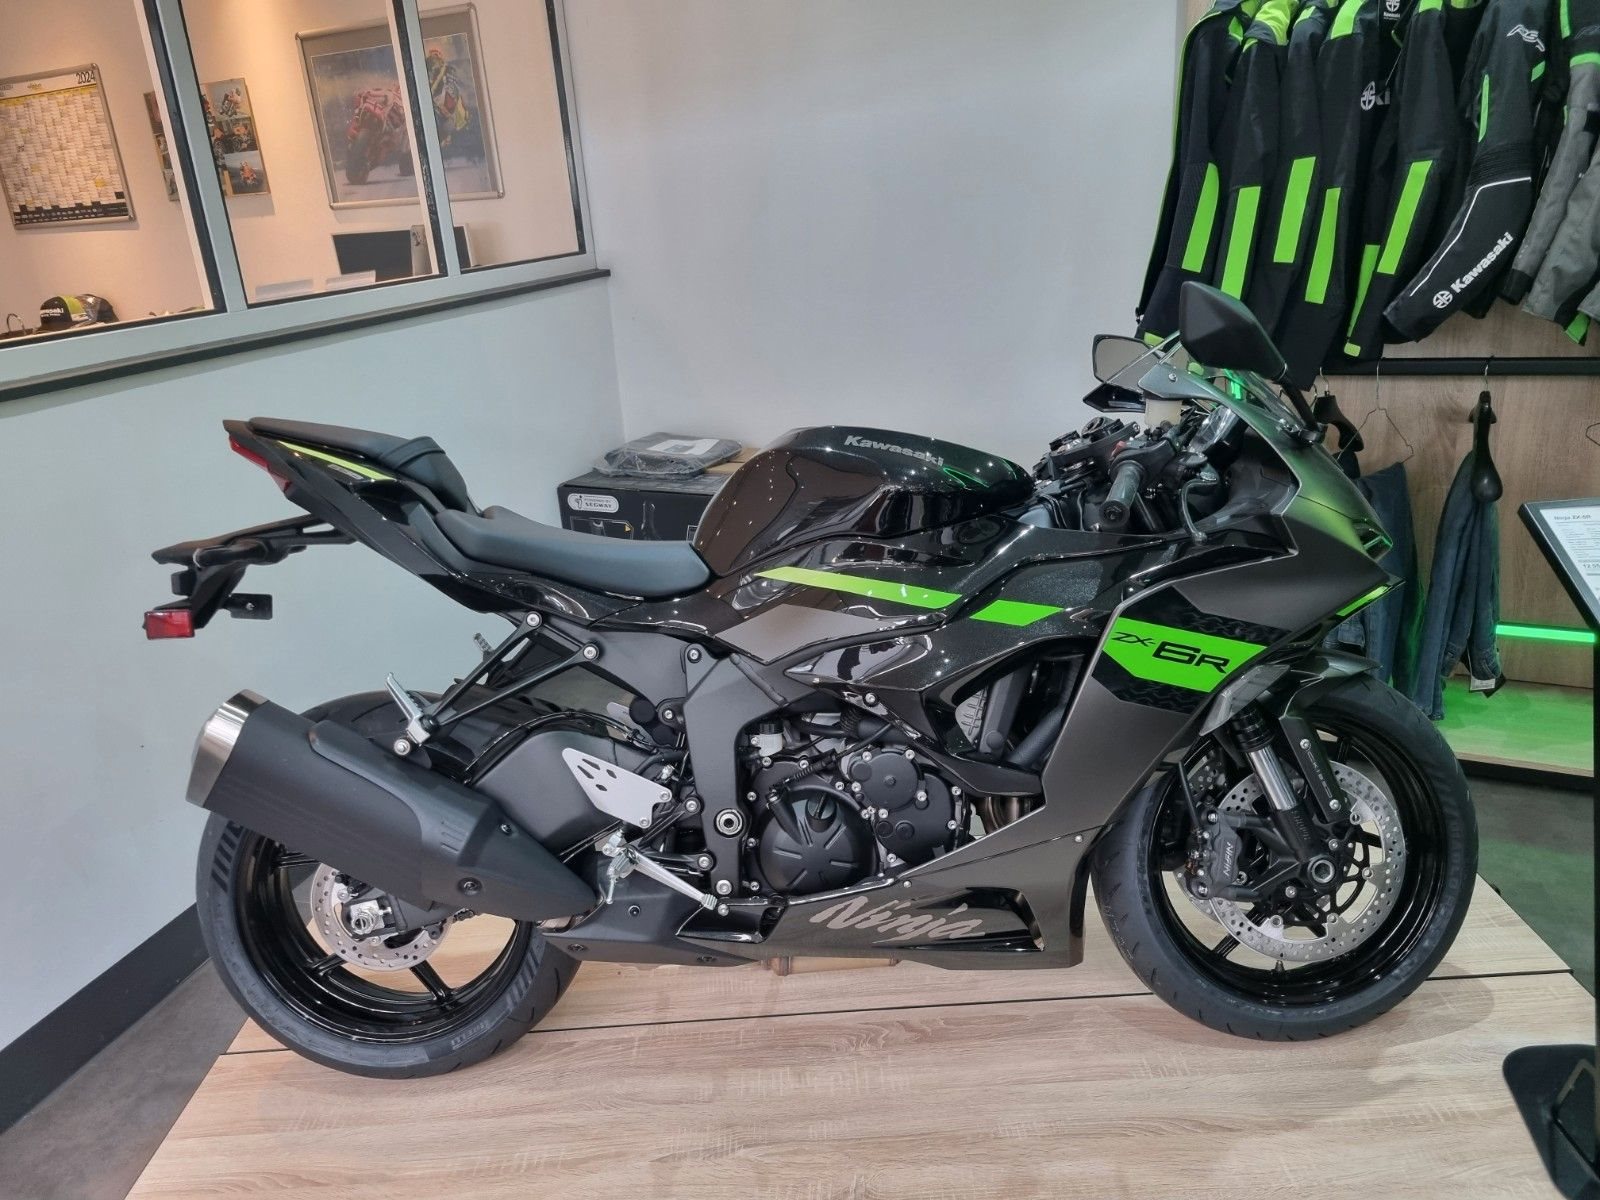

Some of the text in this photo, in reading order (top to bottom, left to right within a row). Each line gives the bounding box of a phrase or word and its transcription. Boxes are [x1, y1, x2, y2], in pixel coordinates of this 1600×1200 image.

[75, 70, 96, 84] 2024
[1450, 231, 1514, 293] Kawasaki
[843, 435, 945, 467] Kawasaki
[808, 896, 986, 944] Ninja
